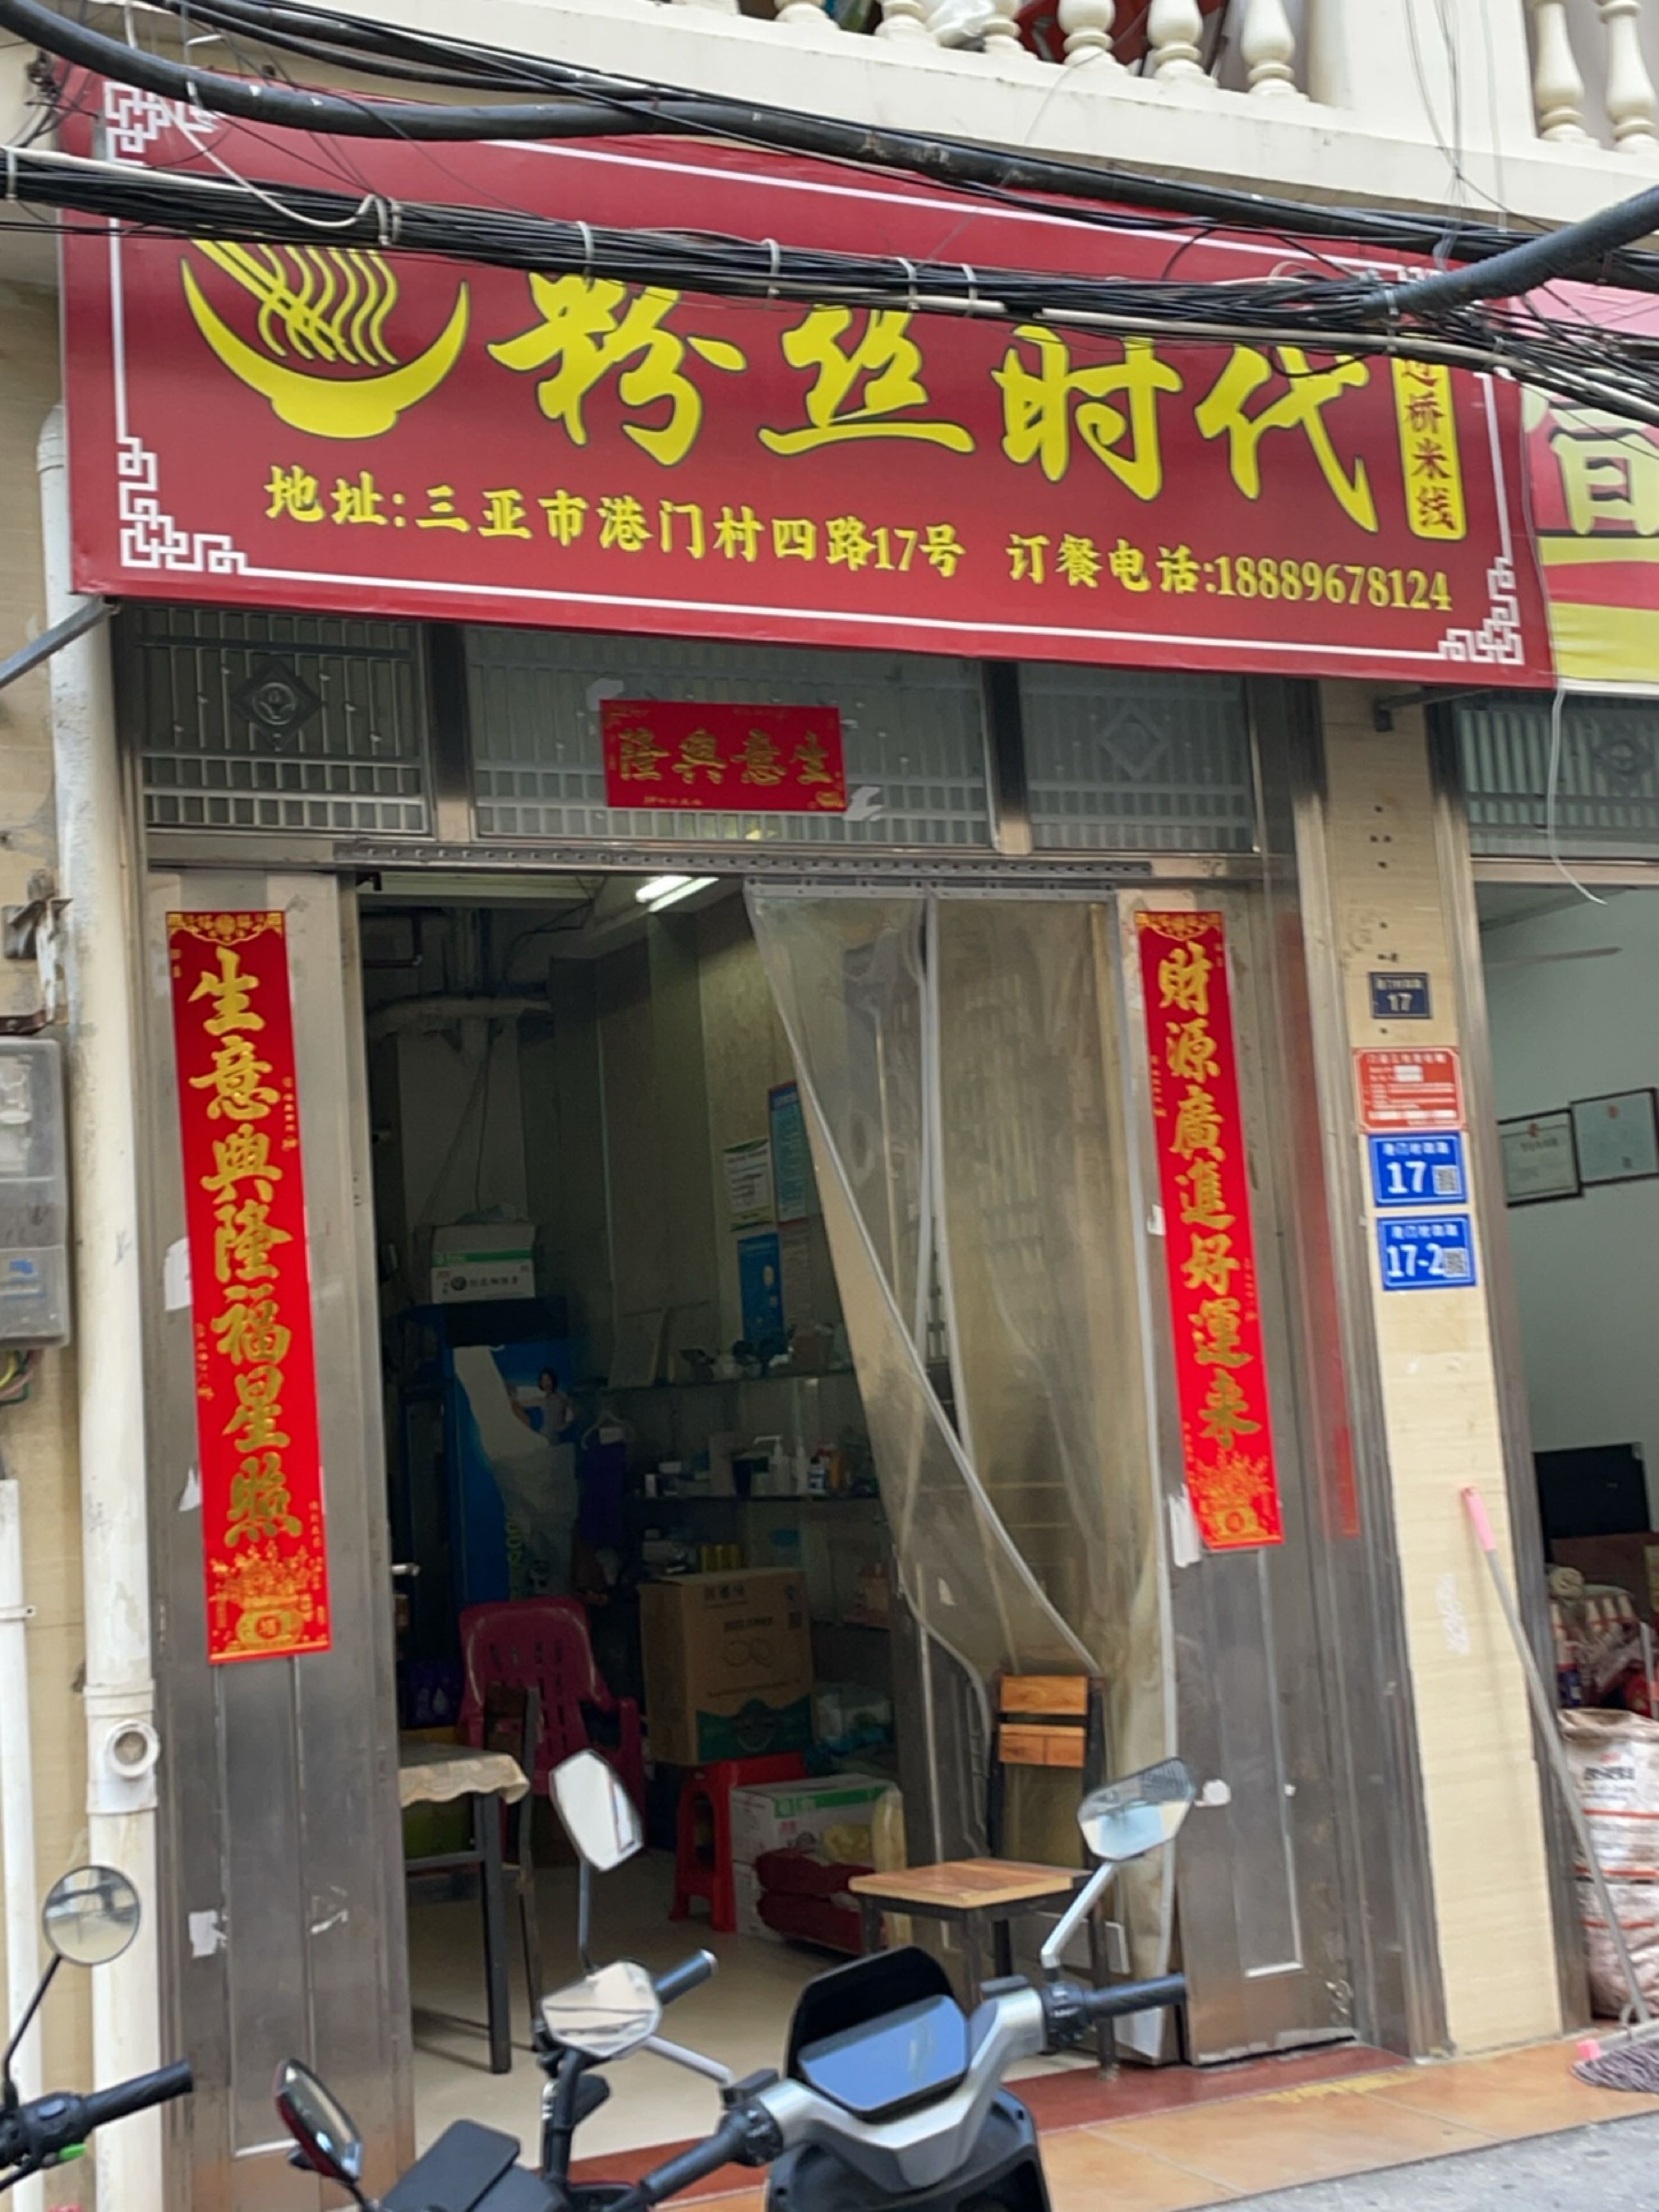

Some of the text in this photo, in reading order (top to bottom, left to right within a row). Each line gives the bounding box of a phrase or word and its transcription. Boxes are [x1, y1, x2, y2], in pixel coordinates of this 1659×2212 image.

[487, 271, 1379, 533] 粉丝时代
[1386, 992, 1413, 1012] 17
[1386, 1161, 1427, 1194] 17
[1386, 1243, 1445, 1278] 17-2
